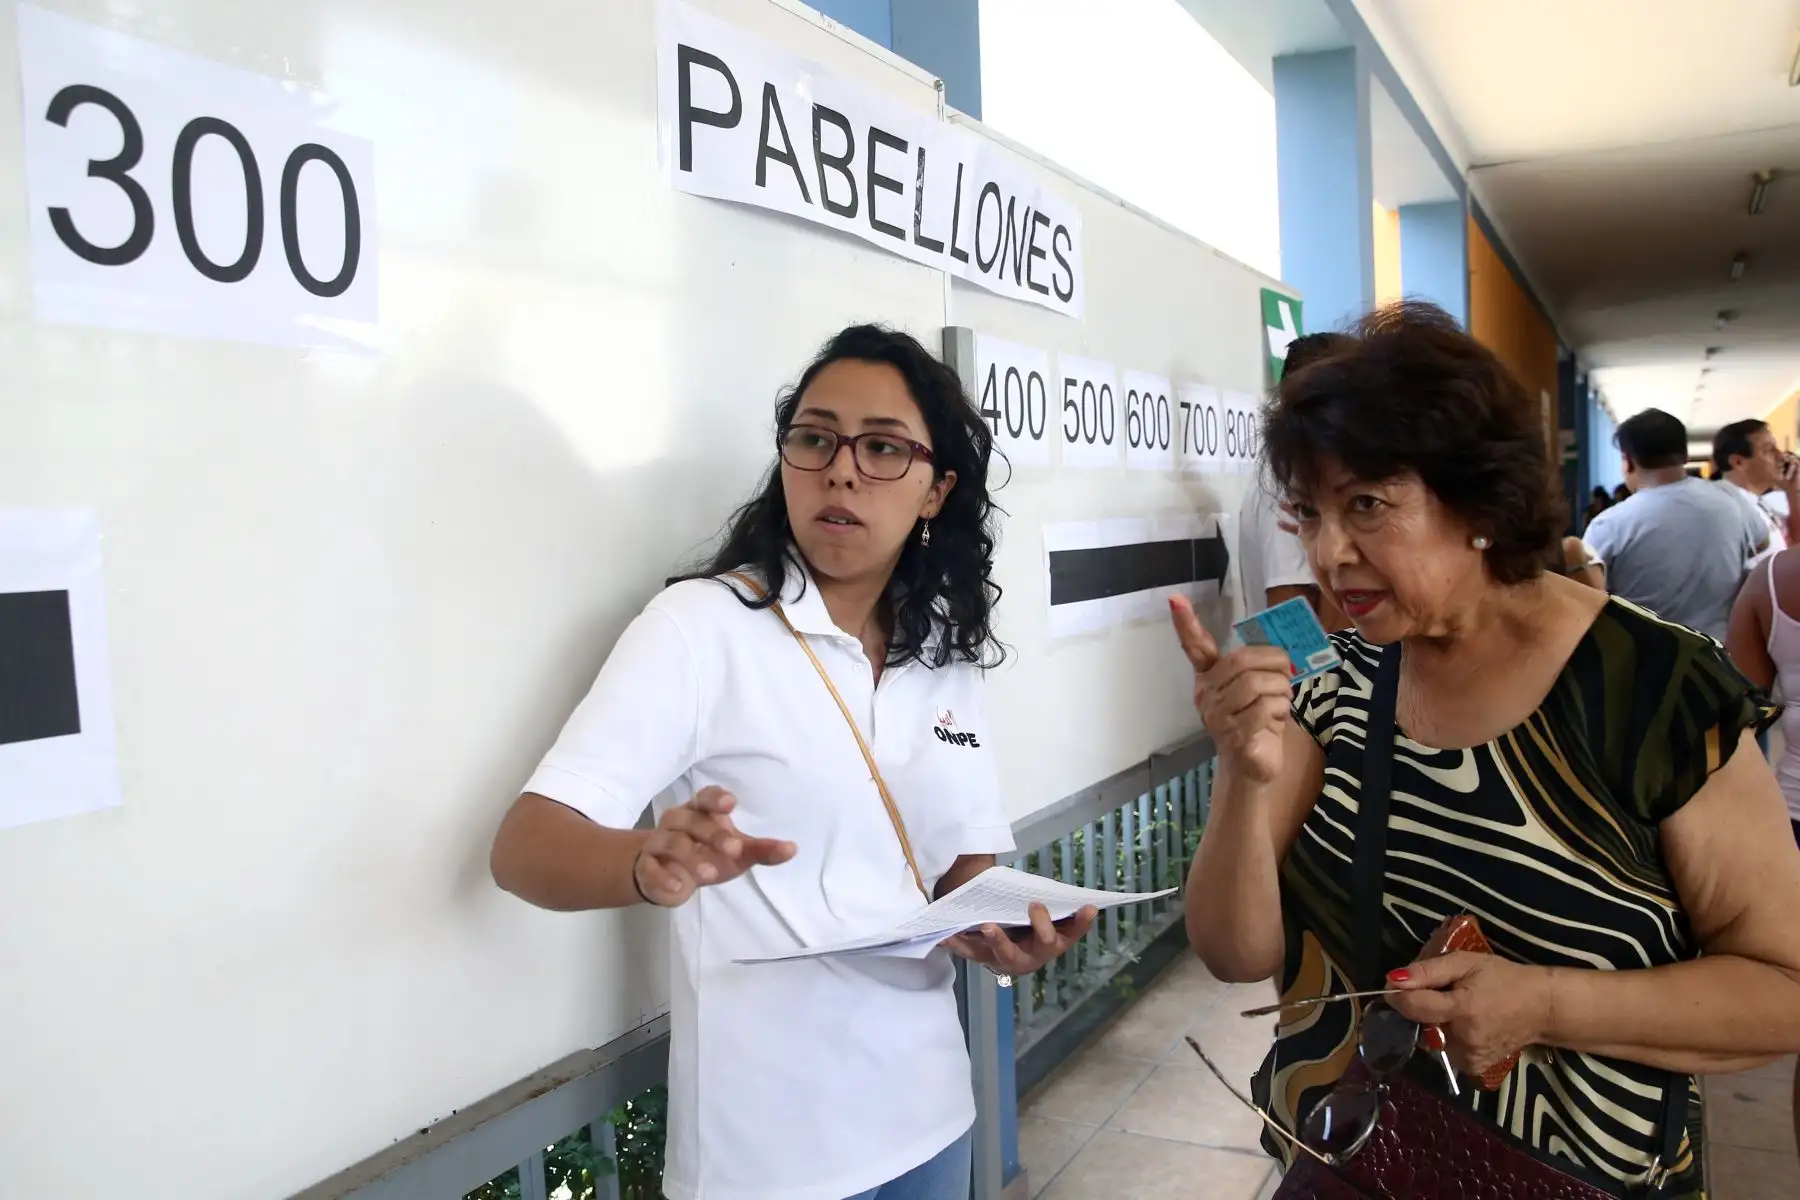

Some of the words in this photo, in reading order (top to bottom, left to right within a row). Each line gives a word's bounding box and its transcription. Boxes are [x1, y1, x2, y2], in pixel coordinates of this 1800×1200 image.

[45, 83, 362, 299] 300
[677, 43, 1074, 303] PABELLONES
[980, 362, 1046, 441] 400
[1063, 377, 1115, 445] 500
[1127, 389, 1170, 451] 600
[1180, 401, 1218, 456] 700
[1225, 408, 1256, 459] 800
[933, 725, 981, 748] ONPE
